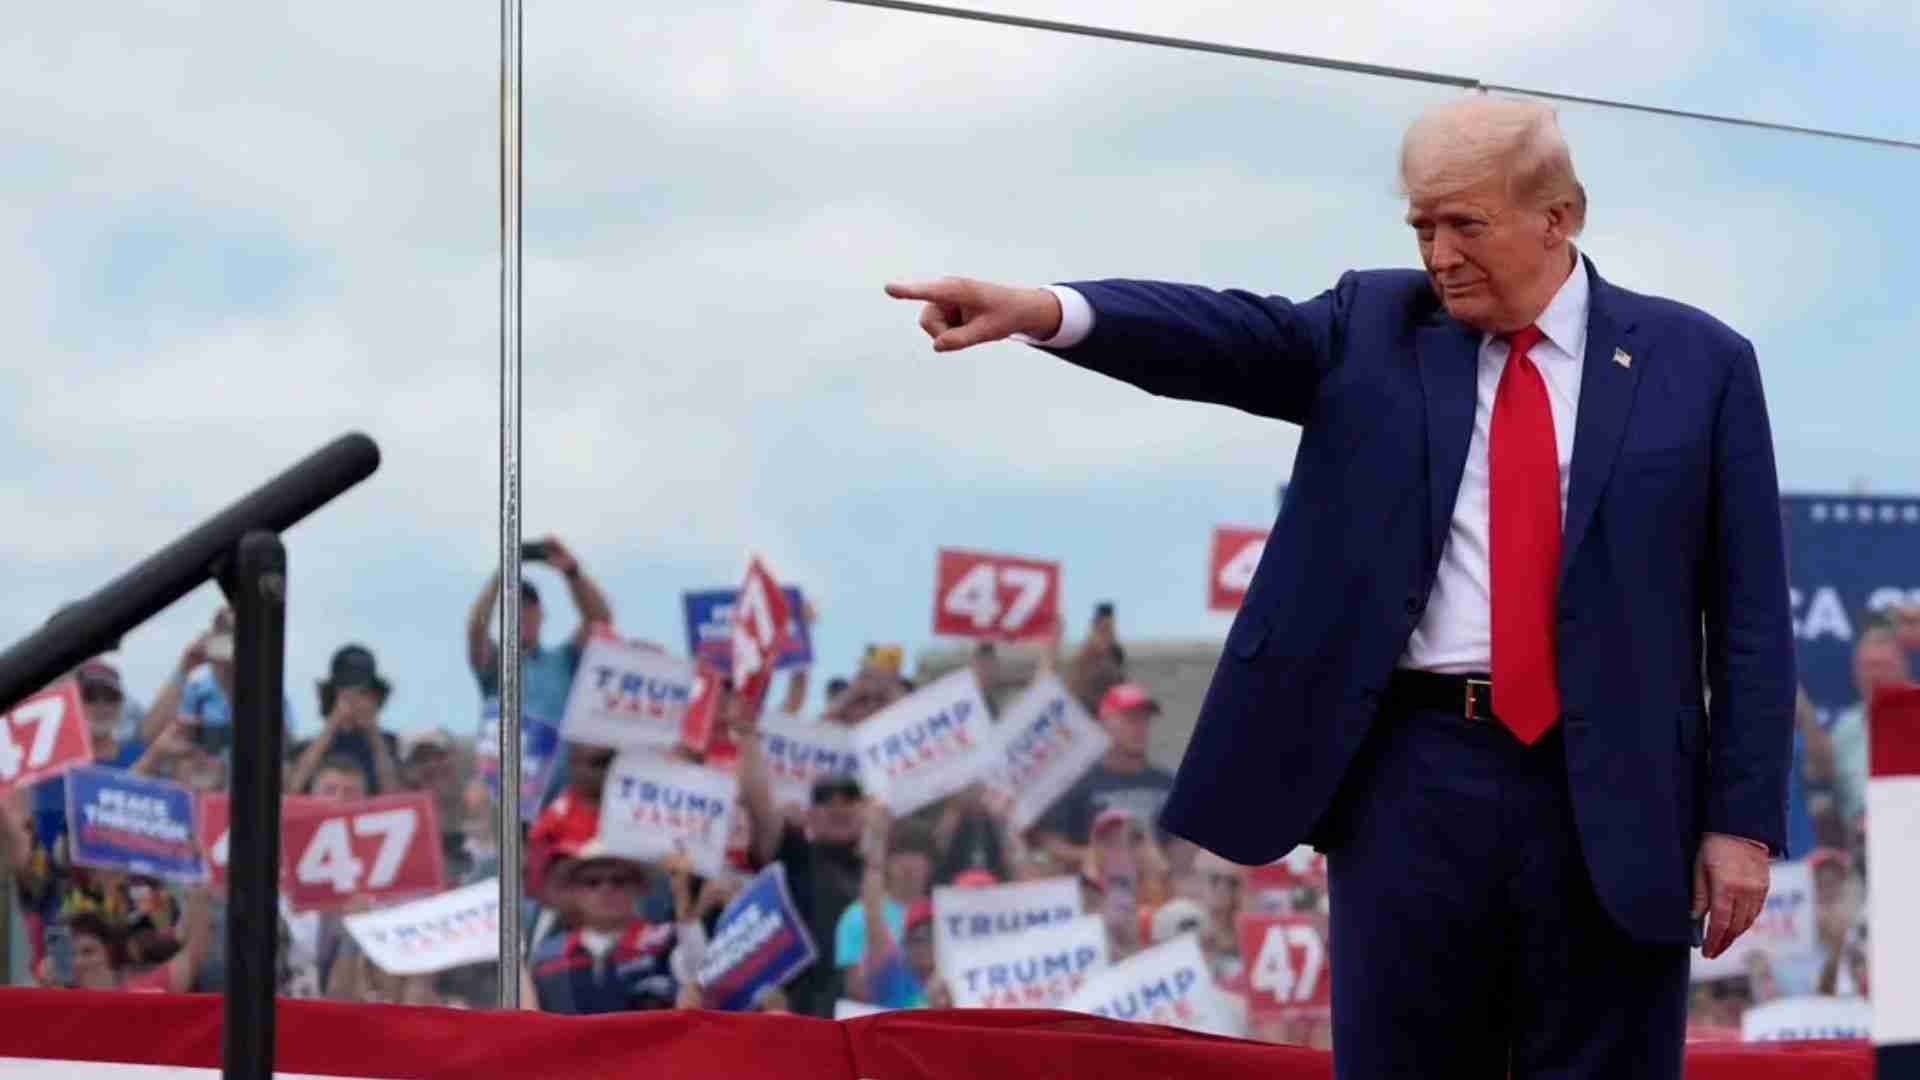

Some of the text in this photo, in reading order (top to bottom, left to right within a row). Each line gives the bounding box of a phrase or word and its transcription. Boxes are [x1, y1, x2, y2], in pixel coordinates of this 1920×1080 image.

[944, 562, 1049, 629] 47
[592, 664, 689, 703] TRUM
[765, 734, 863, 777] RUMP
[864, 700, 972, 769] TRUMP
[617, 775, 725, 818] TRUMP
[297, 809, 416, 892] 47
[947, 904, 1074, 937] TRUMP
[966, 944, 1096, 993] TRUMP
[1251, 924, 1323, 1003] 47
